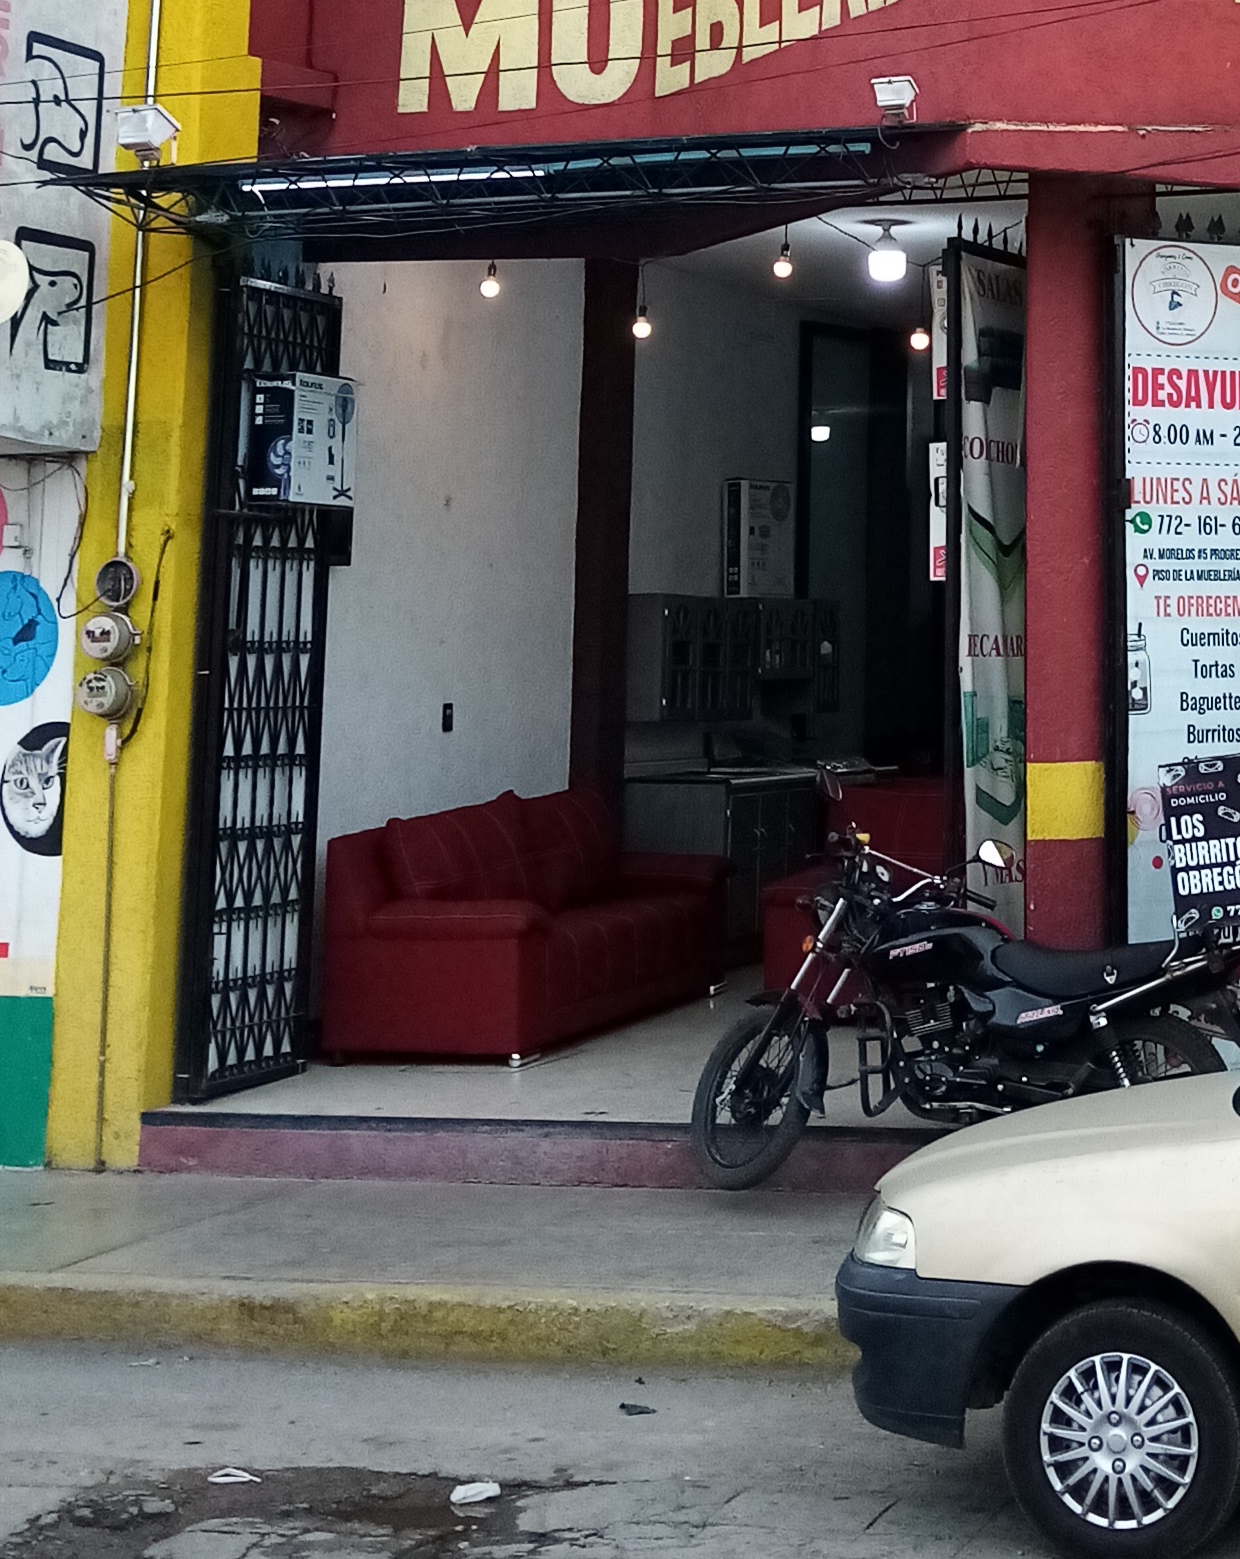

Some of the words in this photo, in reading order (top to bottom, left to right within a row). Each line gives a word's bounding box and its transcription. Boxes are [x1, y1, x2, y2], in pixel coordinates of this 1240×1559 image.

[1195, 428, 1215, 447] AM
[1130, 476, 1193, 506] LUNES
[1199, 478, 1212, 506] A
[1157, 515, 1191, 536] 772-
[1197, 515, 1226, 536] 161-
[1142, 548, 1156, 560] AV.
[1158, 548, 1196, 560] MORELOS
[1152, 569, 1171, 581] PISO
[1172, 569, 1183, 581] DE
[1184, 569, 1195, 581] LA
[1196, 567, 1240, 581] MUEBLERÍA
[1154, 595, 1171, 617] TE
[1192, 659, 1235, 679] Tortas
[1166, 782, 1215, 795] SERVICIO
[1217, 780, 1225, 788] A
[1170, 792, 1227, 807] DOMICILIO
[1170, 813, 1205, 841] LOS
